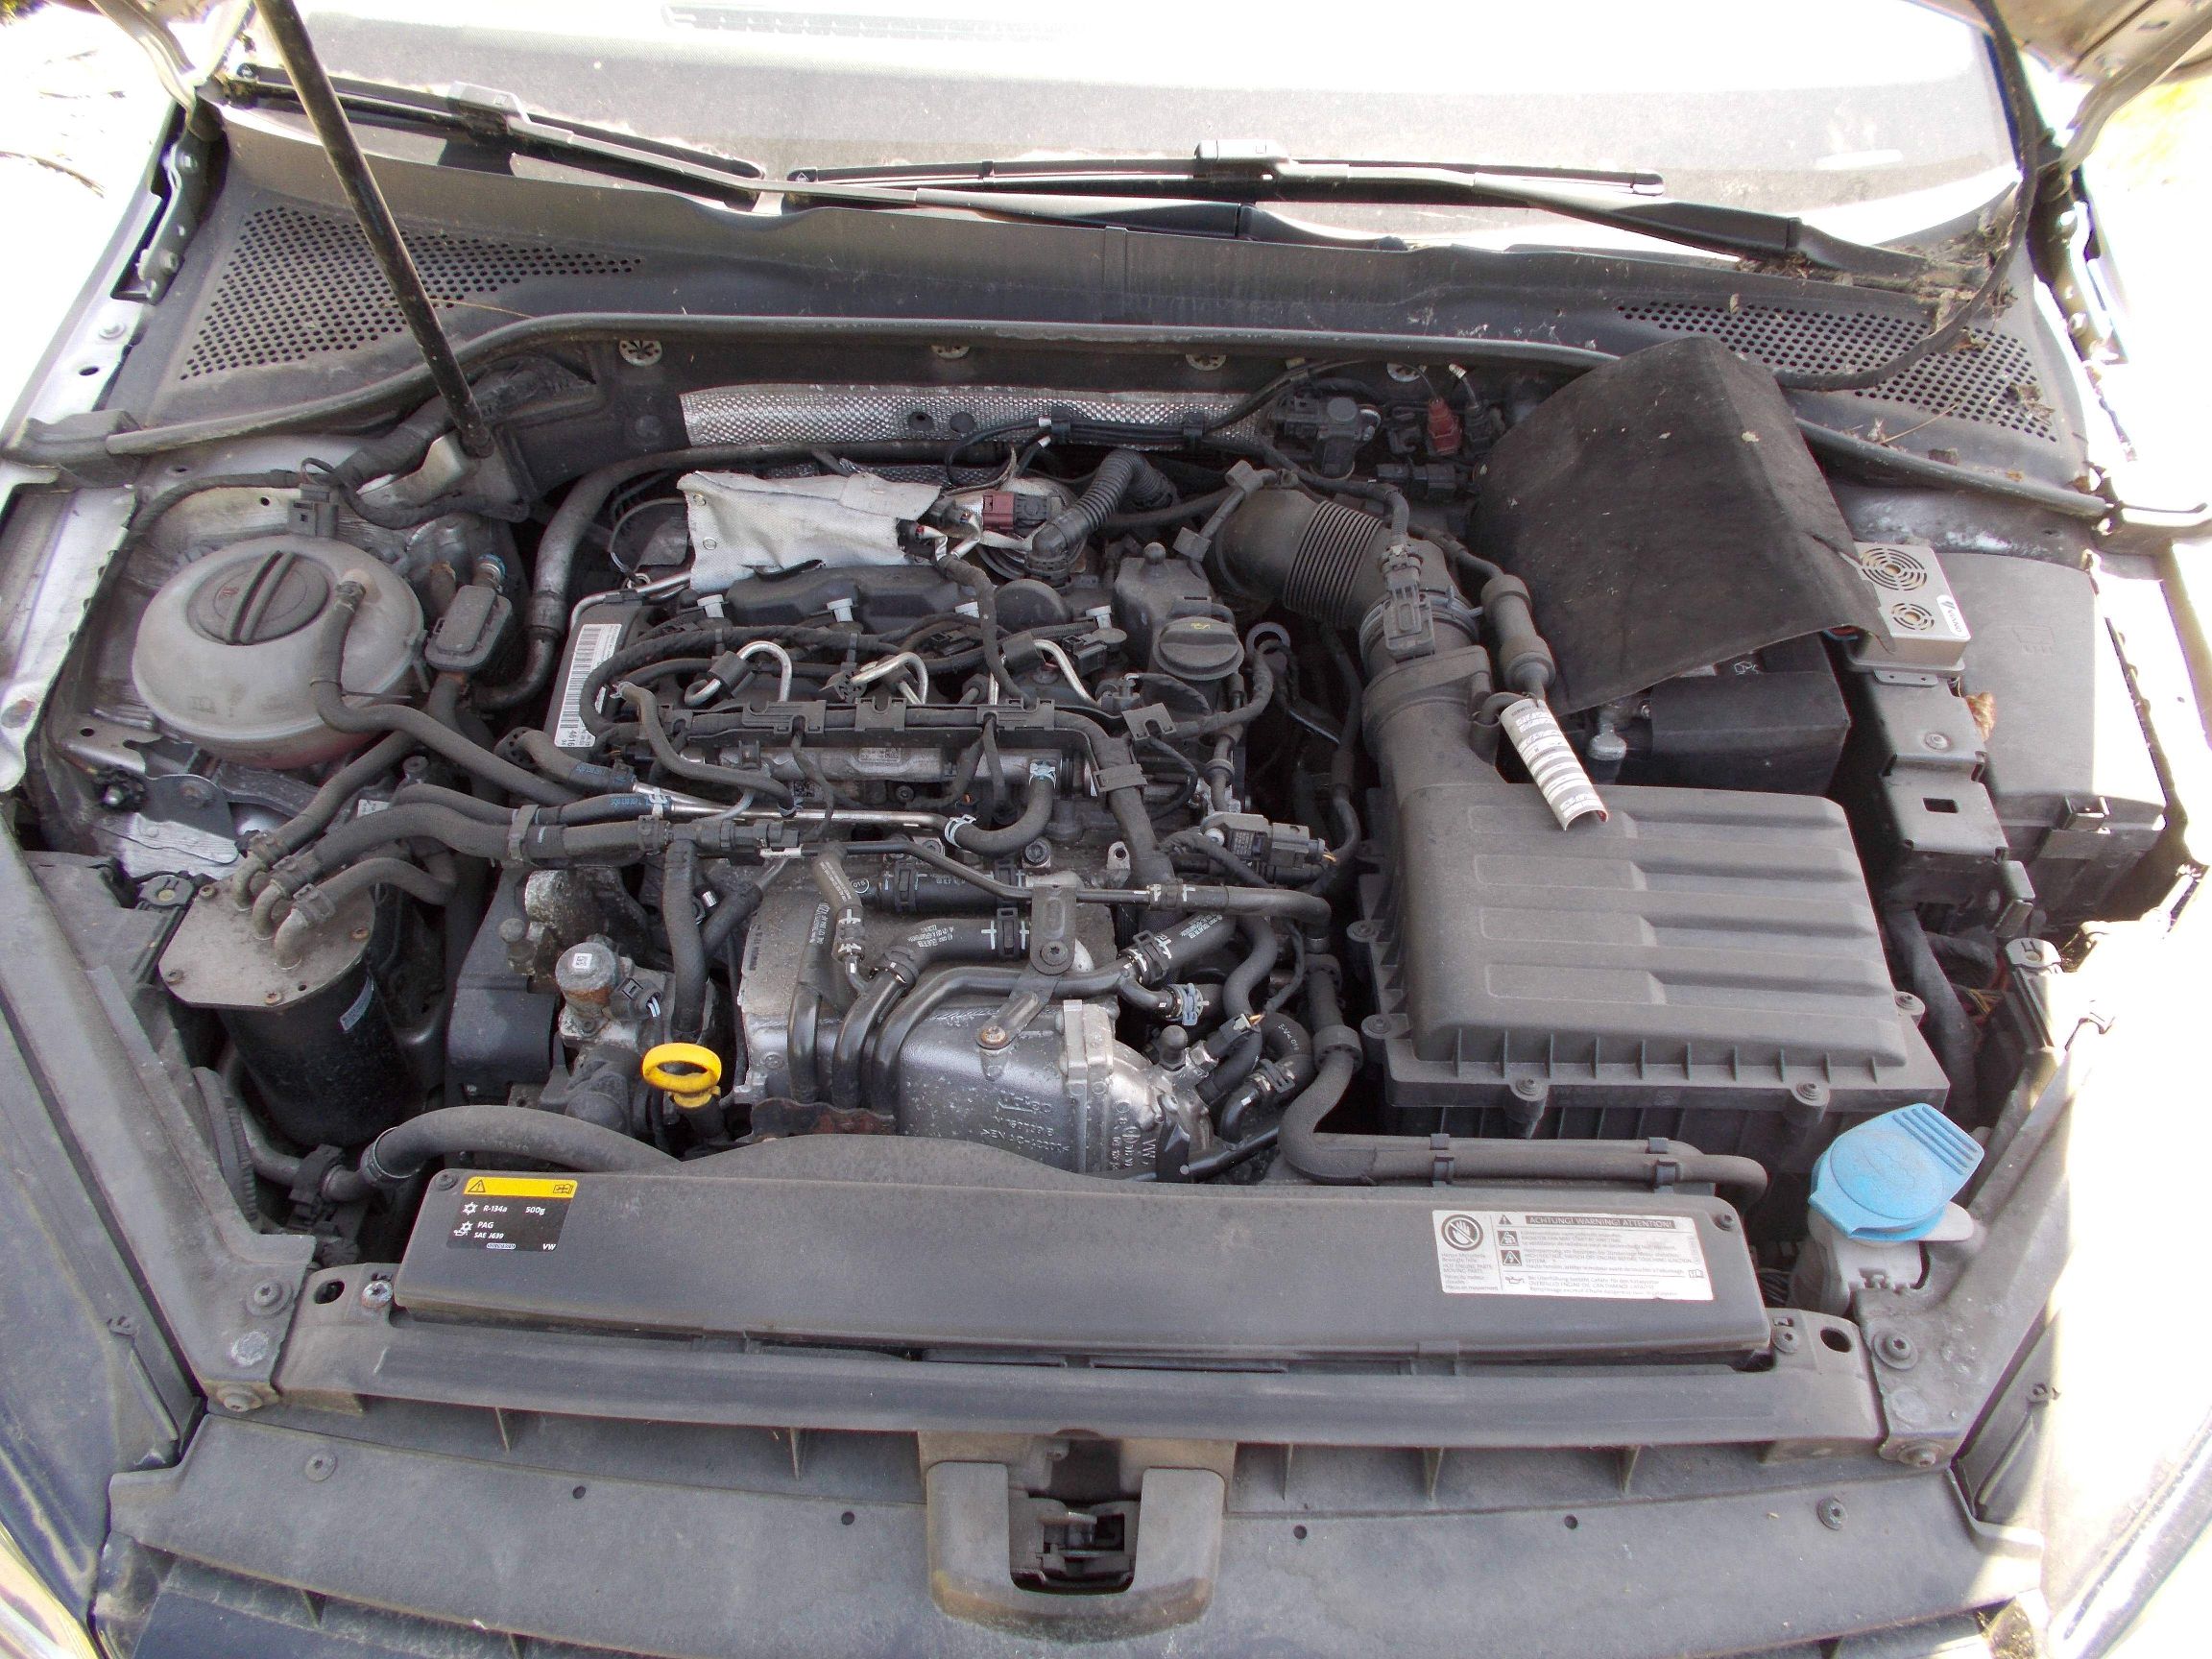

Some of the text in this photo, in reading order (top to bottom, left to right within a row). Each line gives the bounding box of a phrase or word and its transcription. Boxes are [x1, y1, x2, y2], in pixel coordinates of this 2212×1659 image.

[525, 1206, 545, 1215] 500g
[1528, 1215, 1673, 1228] ACHTUNG! WARNING! ATTENTION!
